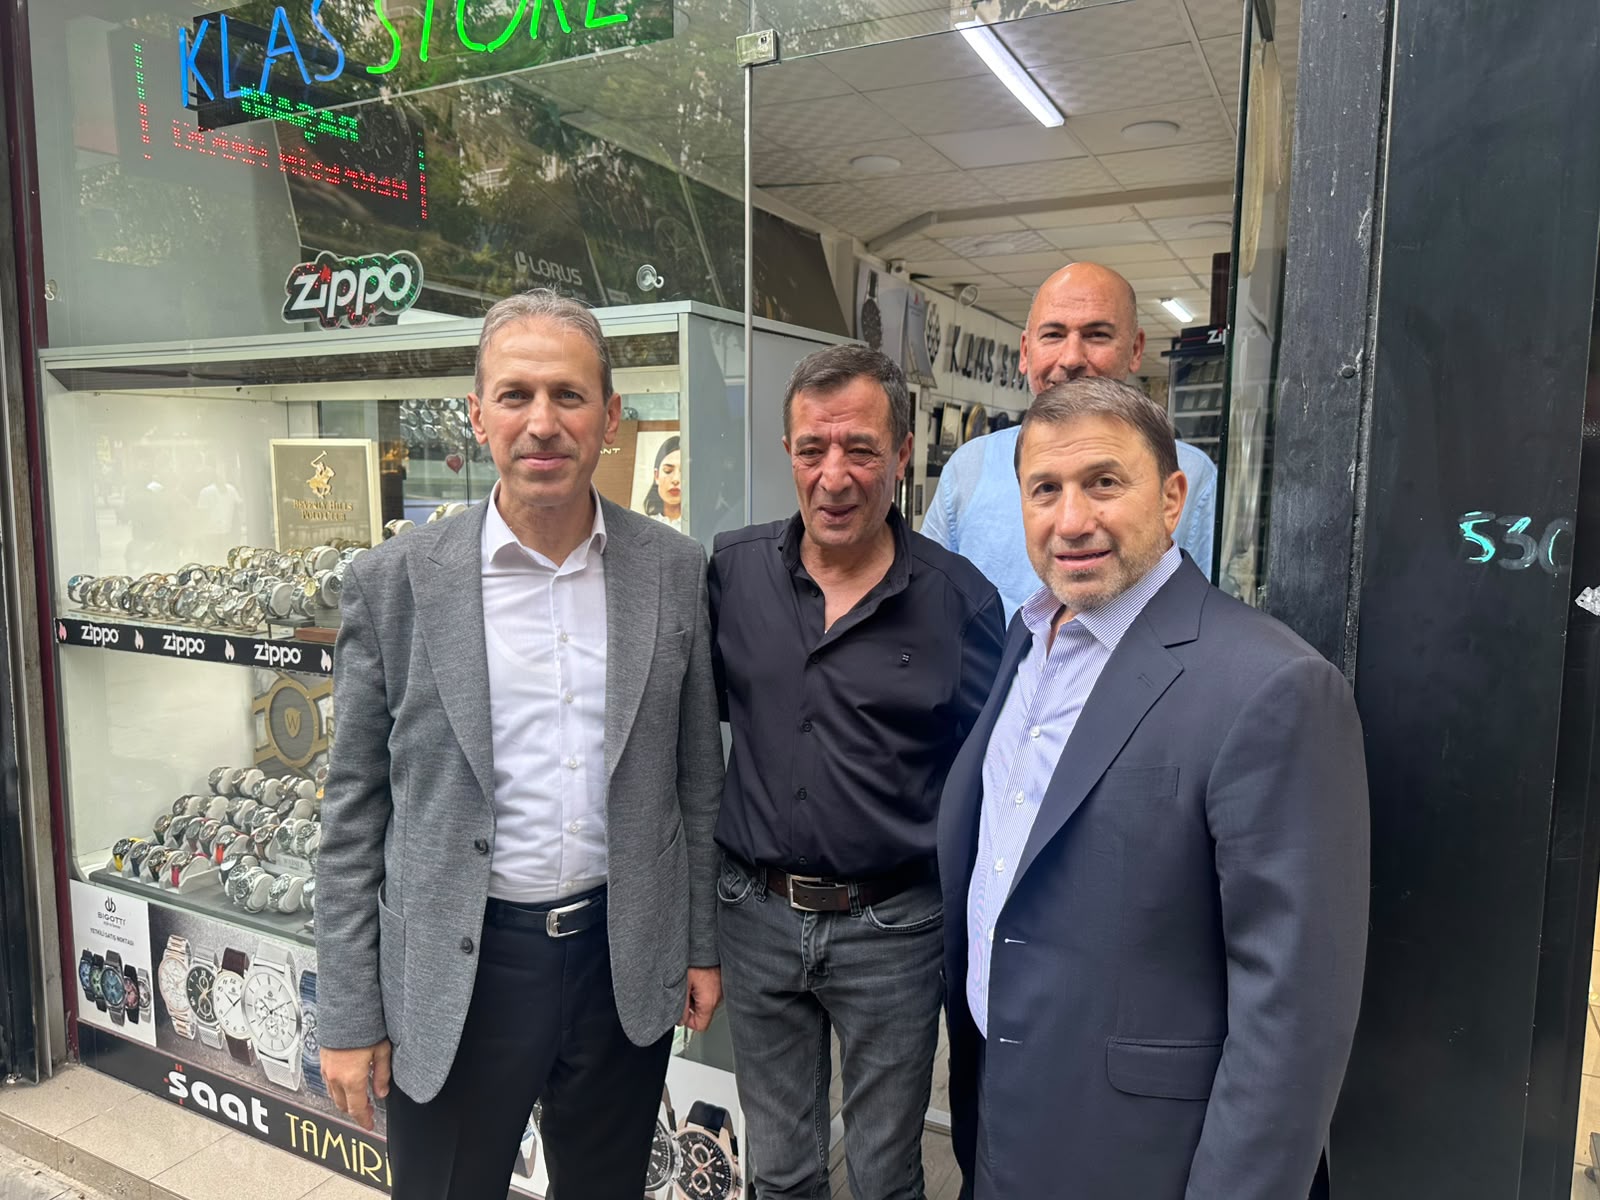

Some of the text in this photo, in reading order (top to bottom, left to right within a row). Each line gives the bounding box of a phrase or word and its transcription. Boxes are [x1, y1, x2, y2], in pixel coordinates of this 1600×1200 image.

[178, 0, 345, 108] KLAS
[528, 255, 583, 286] LORUS
[330, 500, 353, 512] HILLS
[97, 911, 126, 926] BIGOTTI
[166, 1065, 269, 1134] saat
